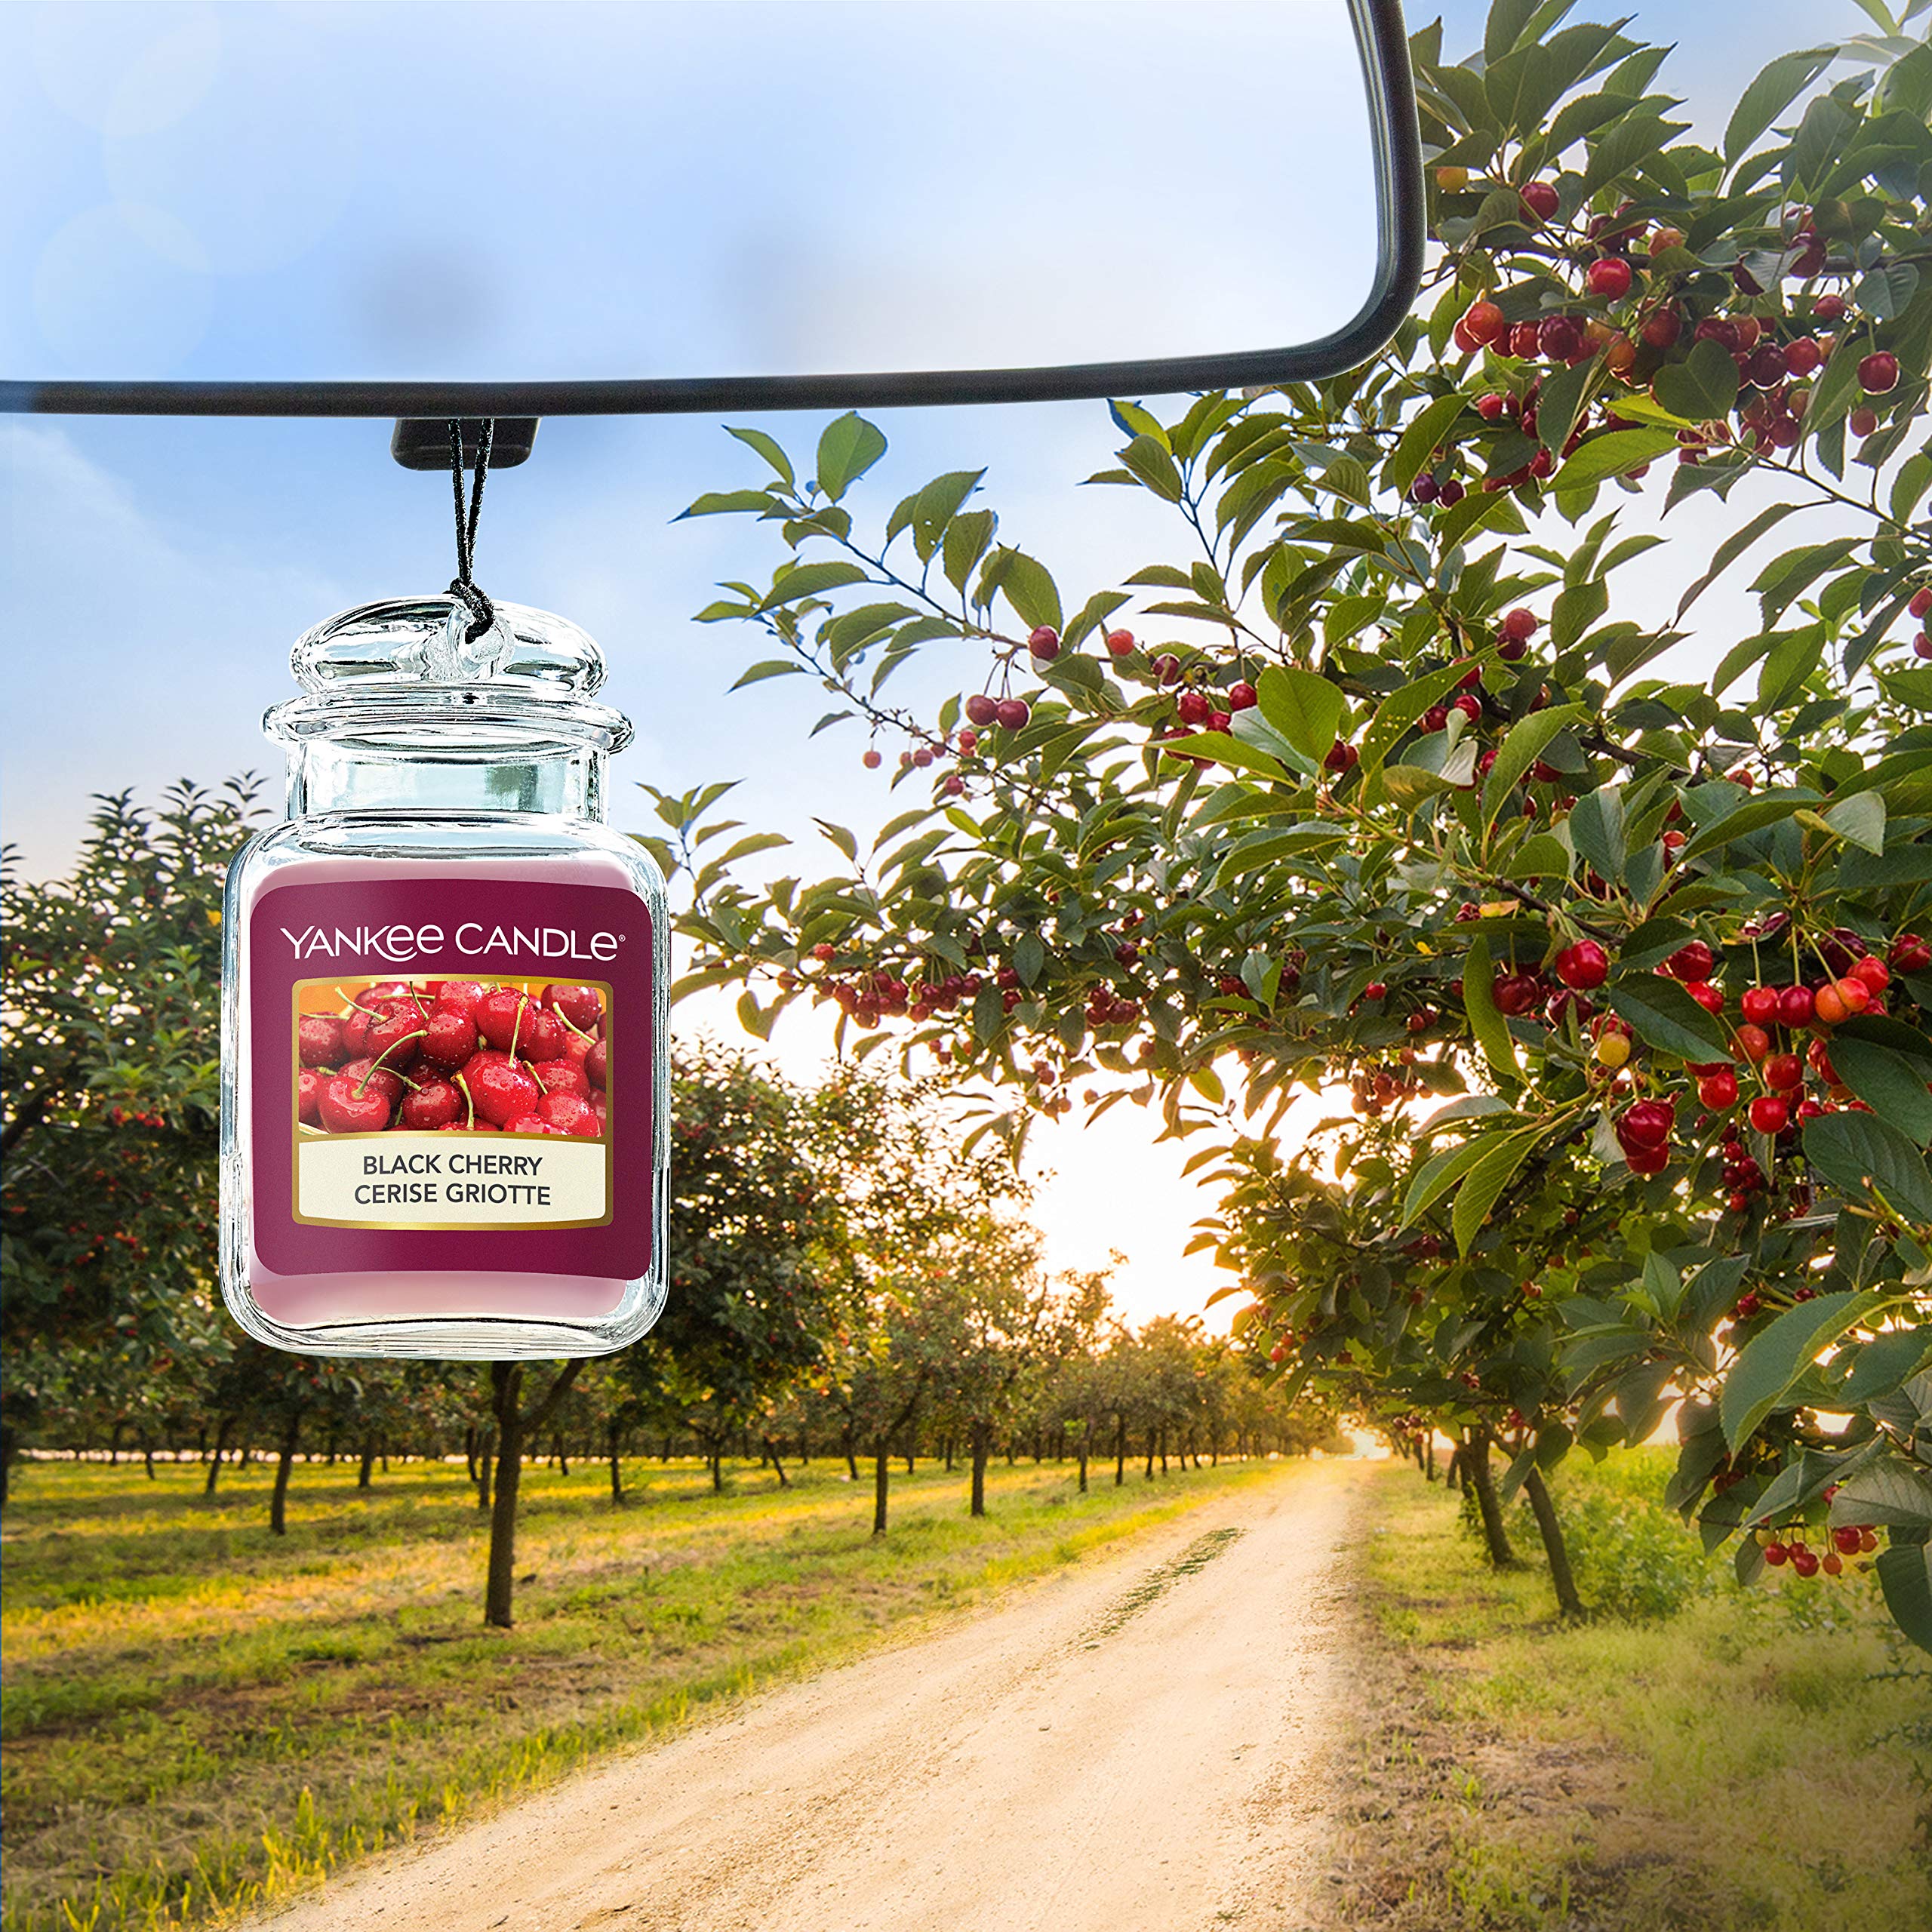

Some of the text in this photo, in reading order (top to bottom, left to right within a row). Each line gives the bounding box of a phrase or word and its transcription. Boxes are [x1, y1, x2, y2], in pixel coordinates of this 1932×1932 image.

[363, 1154, 543, 1176] BLACK CHERRY
[354, 1183, 552, 1206] CERISE GRIOTTE
